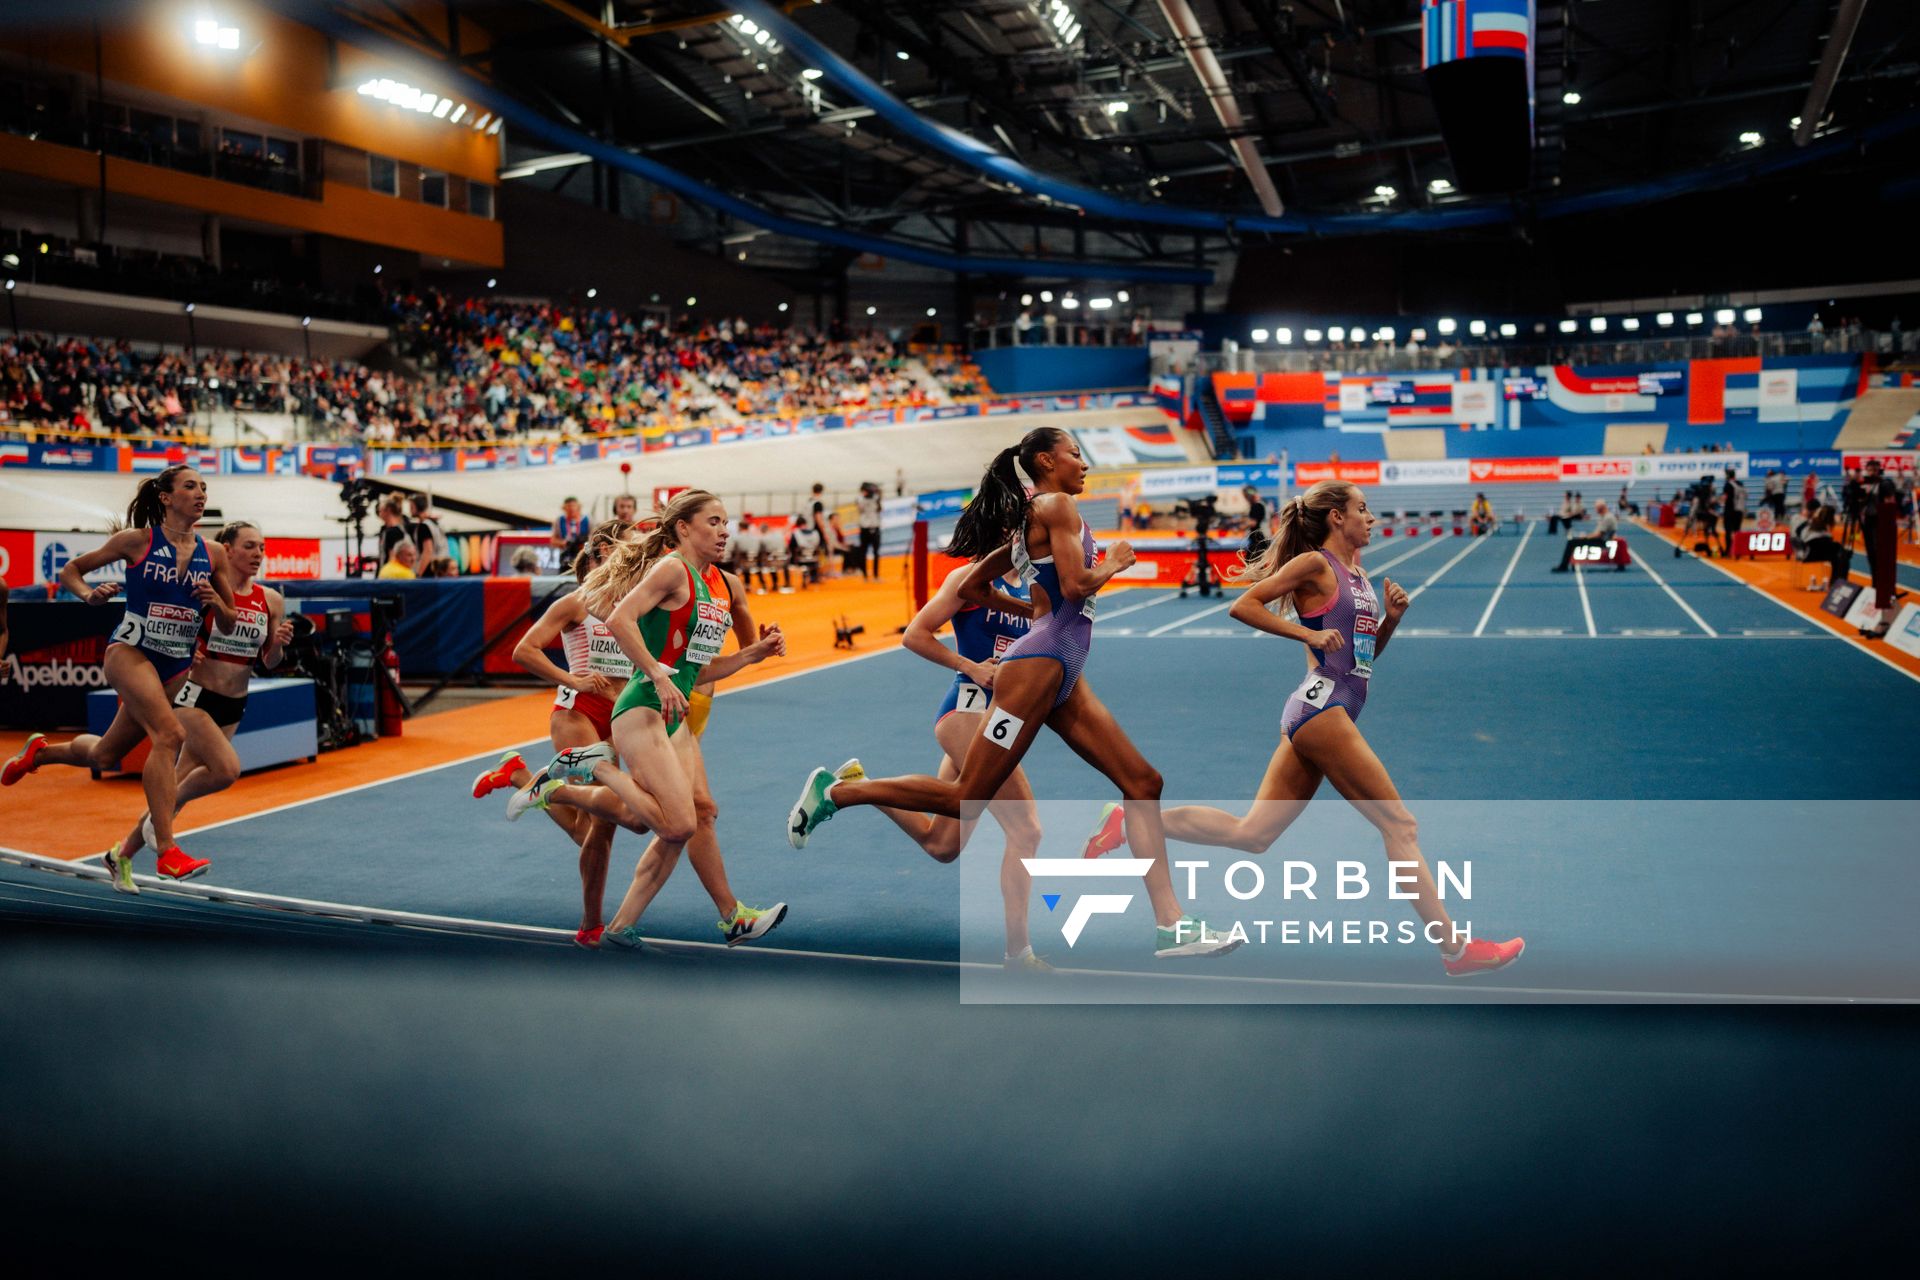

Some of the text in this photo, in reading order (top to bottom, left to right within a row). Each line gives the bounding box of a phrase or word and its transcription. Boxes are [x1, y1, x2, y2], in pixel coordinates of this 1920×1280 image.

[1576, 461, 1632, 475] SPAR
[151, 605, 193, 621] SPAR
[120, 621, 135, 640] 2
[235, 625, 260, 639] IND
[591, 639, 621, 655] LIZAKO
[180, 686, 191, 702] 3
[1306, 680, 1324, 700] 8
[966, 688, 979, 709] 7
[992, 718, 1011, 740] 6
